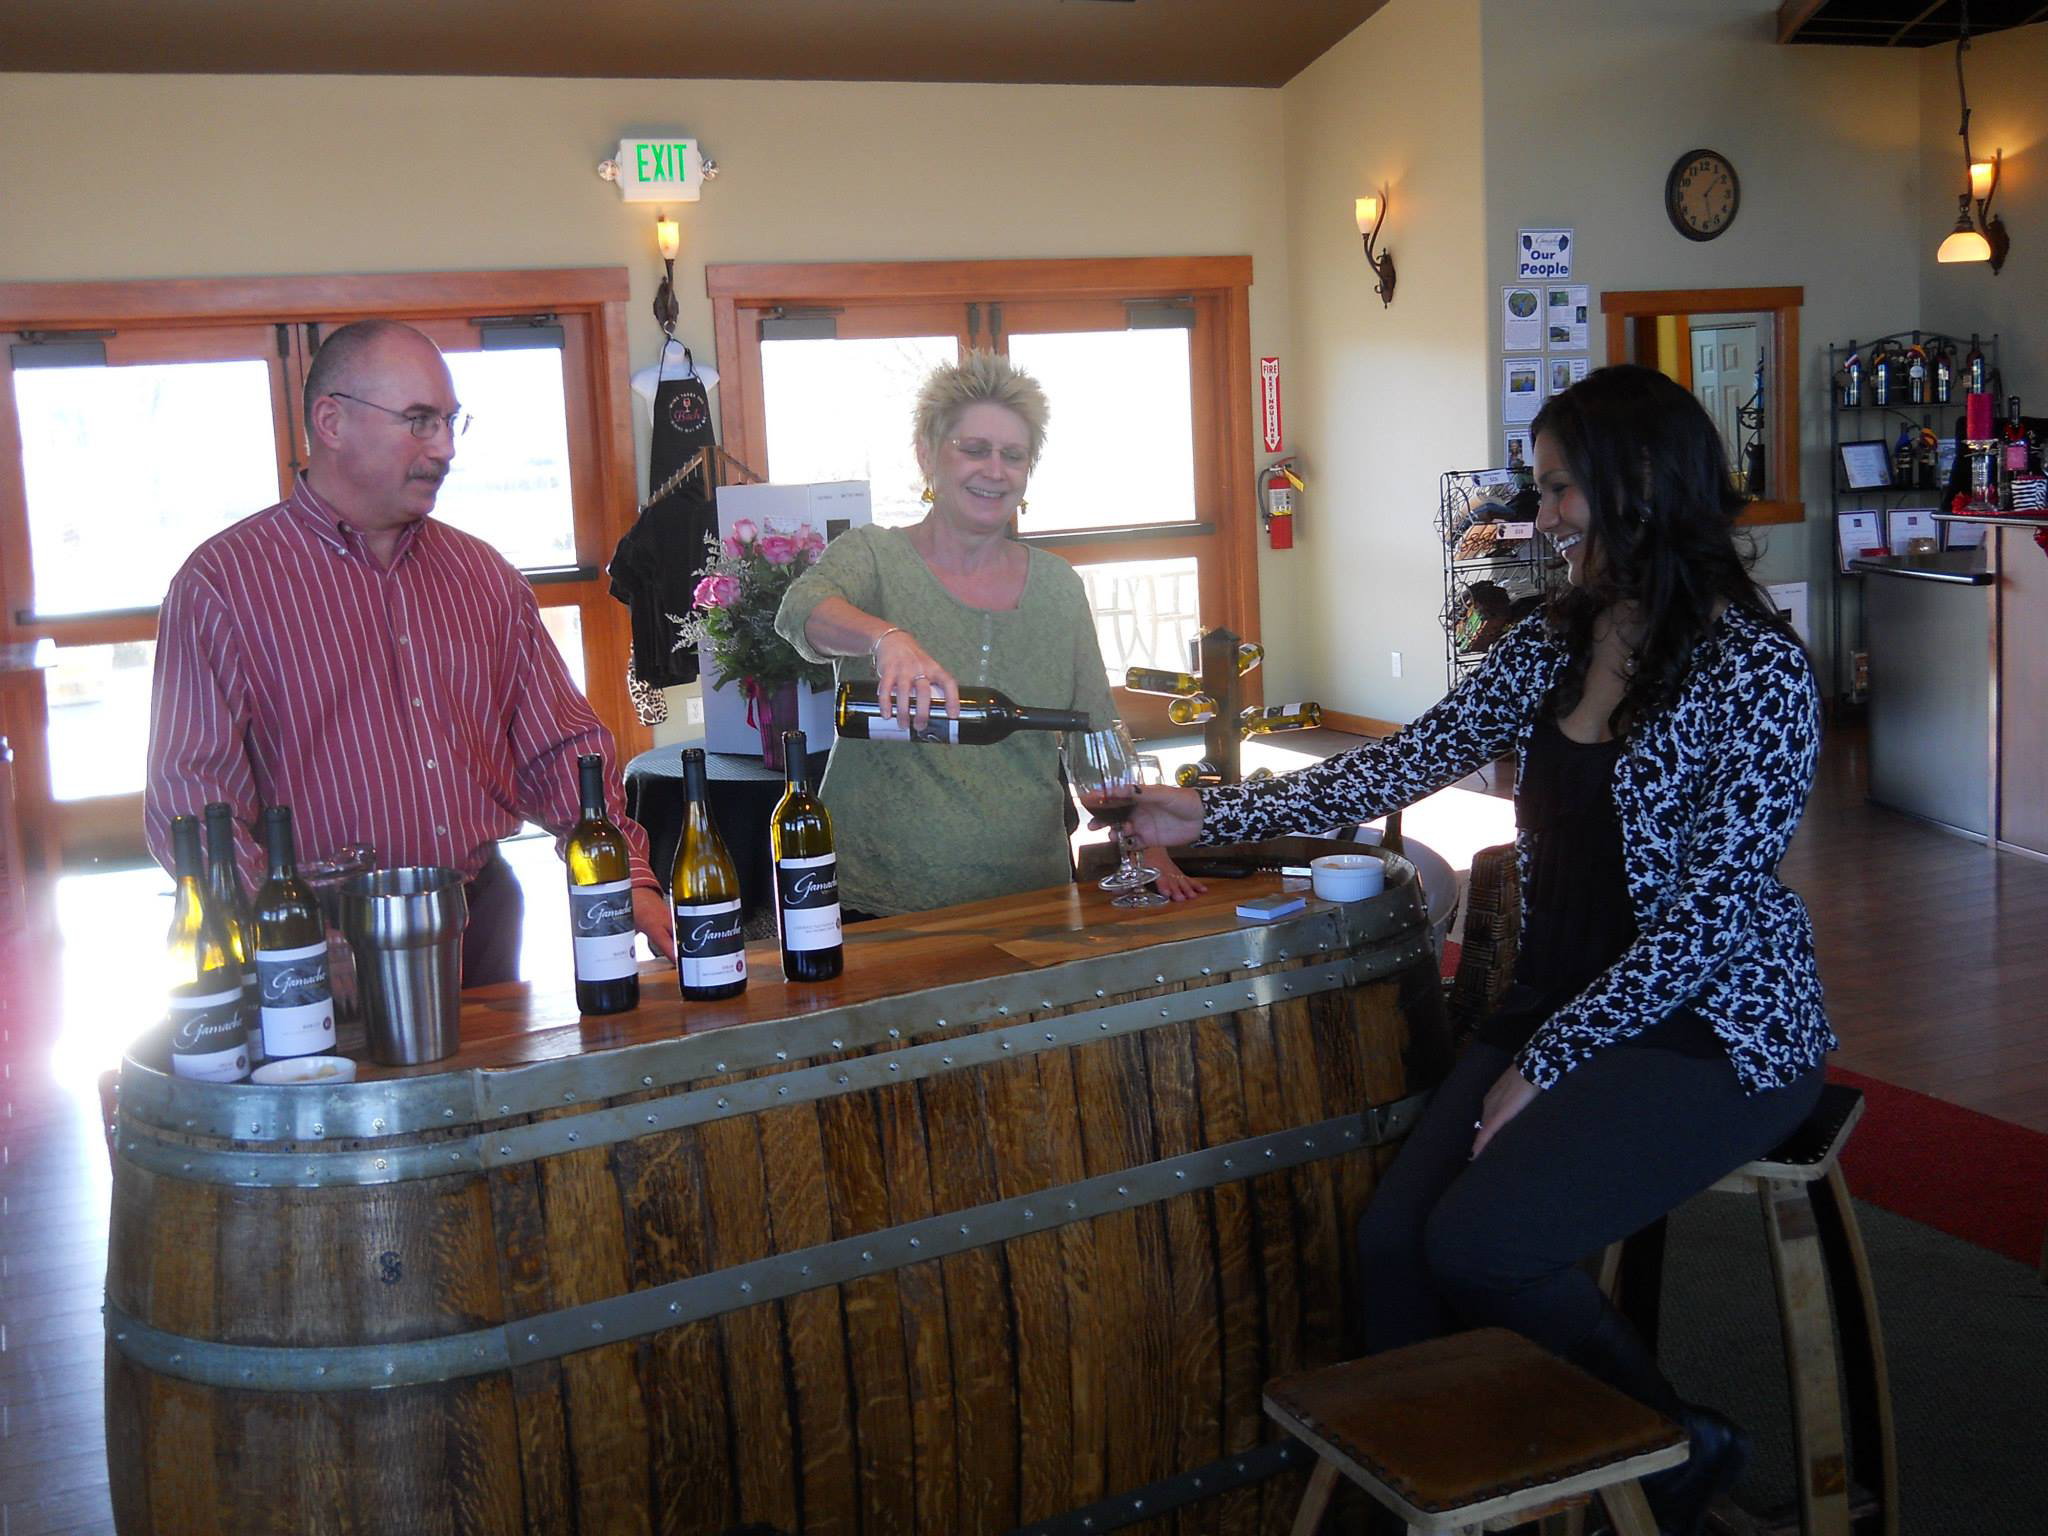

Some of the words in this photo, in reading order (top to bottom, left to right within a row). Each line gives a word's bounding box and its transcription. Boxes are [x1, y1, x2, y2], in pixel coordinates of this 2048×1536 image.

[636, 143, 688, 182] EXIT
[1700, 161, 1710, 171] 12
[1531, 250, 1555, 260] Our
[1521, 262, 1568, 277] People
[1264, 365, 1278, 374] FIRE
